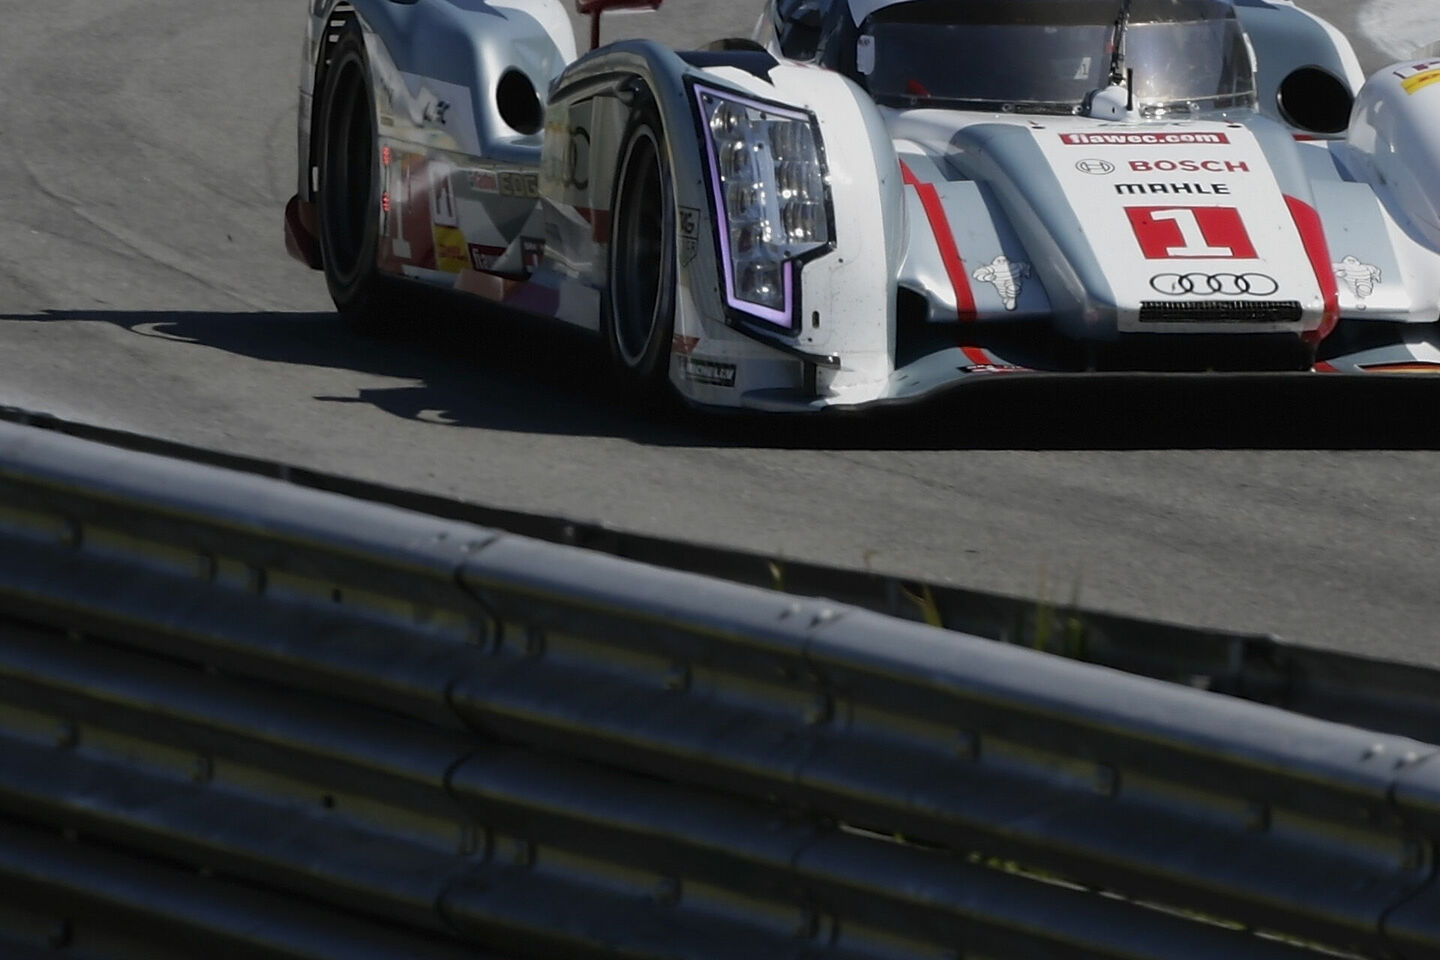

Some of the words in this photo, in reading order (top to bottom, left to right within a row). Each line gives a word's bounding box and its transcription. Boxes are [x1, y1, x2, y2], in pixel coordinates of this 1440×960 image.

[1068, 132, 1220, 145] fiawec.com
[1128, 160, 1250, 173] BOSCH
[1114, 183, 1231, 195] MAHLE
[1150, 208, 1233, 257] 1
